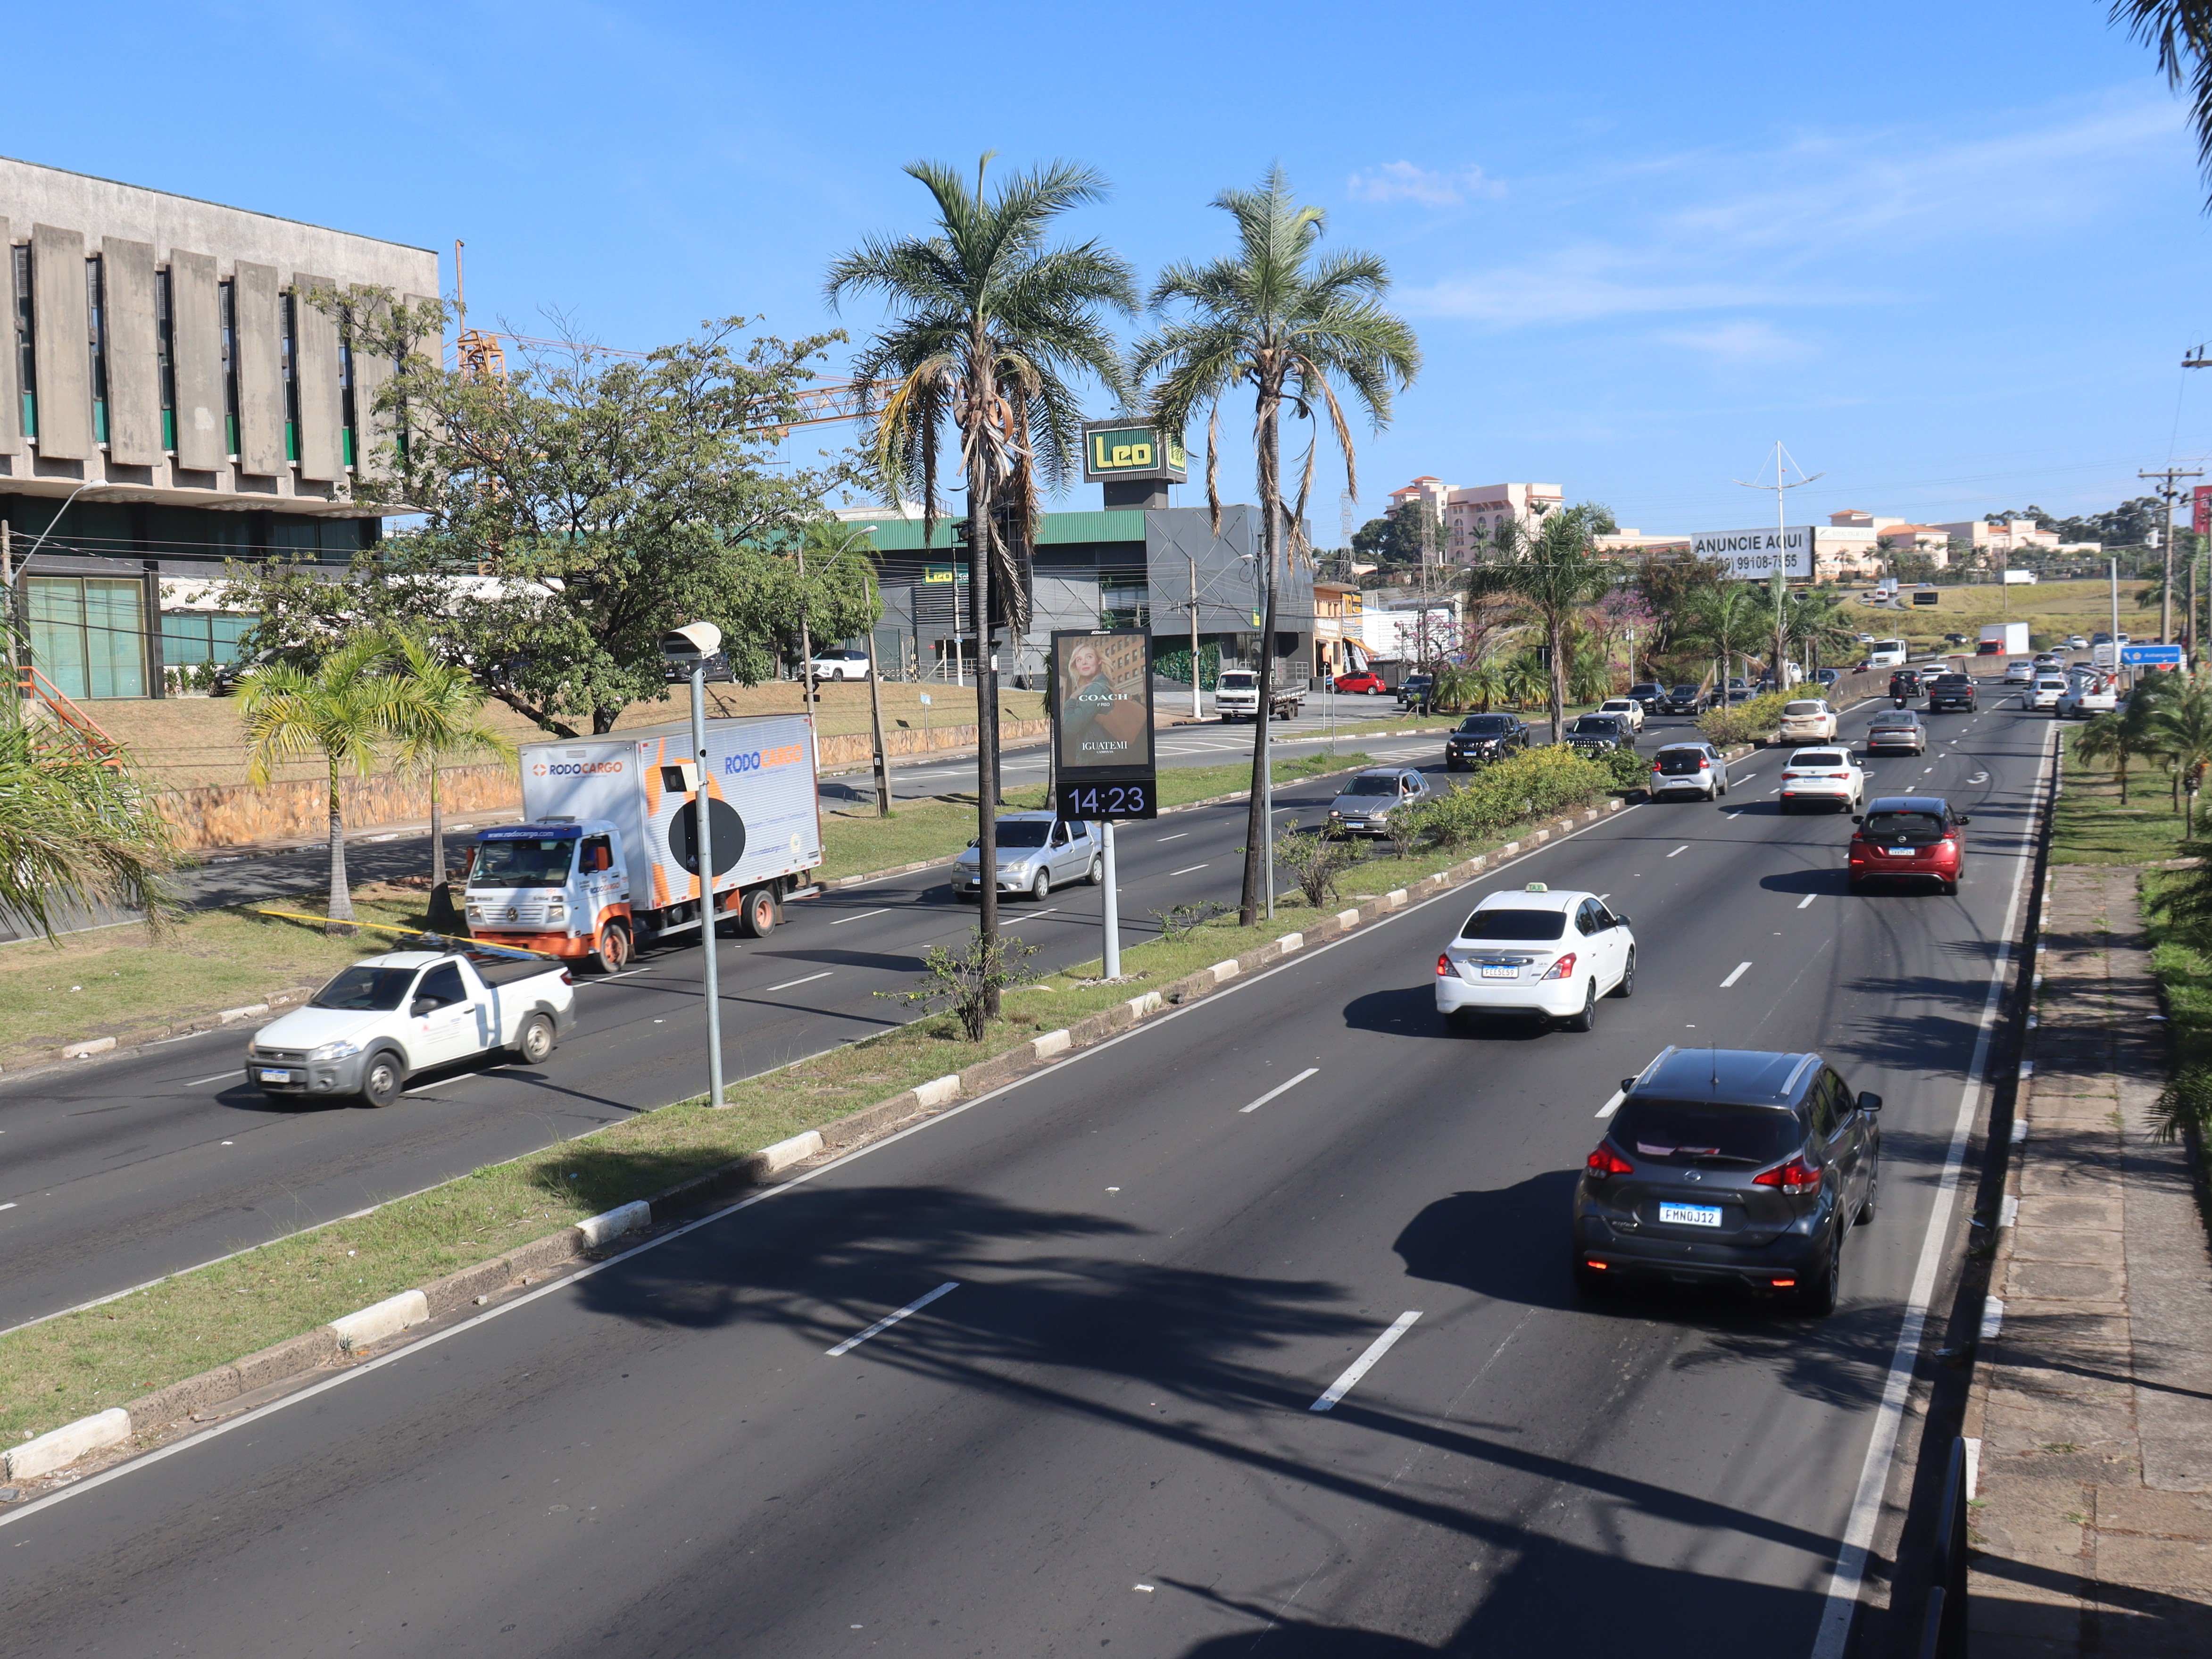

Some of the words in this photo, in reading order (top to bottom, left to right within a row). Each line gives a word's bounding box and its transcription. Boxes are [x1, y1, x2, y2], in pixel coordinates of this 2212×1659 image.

[1096, 436, 1152, 468] Leo
[1696, 536, 1761, 553] ANUNCIE
[1766, 533, 1802, 549] AQUI
[925, 567, 953, 583] Leo
[1078, 693, 1128, 701] COACH
[1082, 741, 1128, 750] IGUATEMI
[549, 761, 623, 775] RODOCARGO
[725, 743, 803, 775] RODOCARGO
[1069, 787, 1144, 814] 14:23
